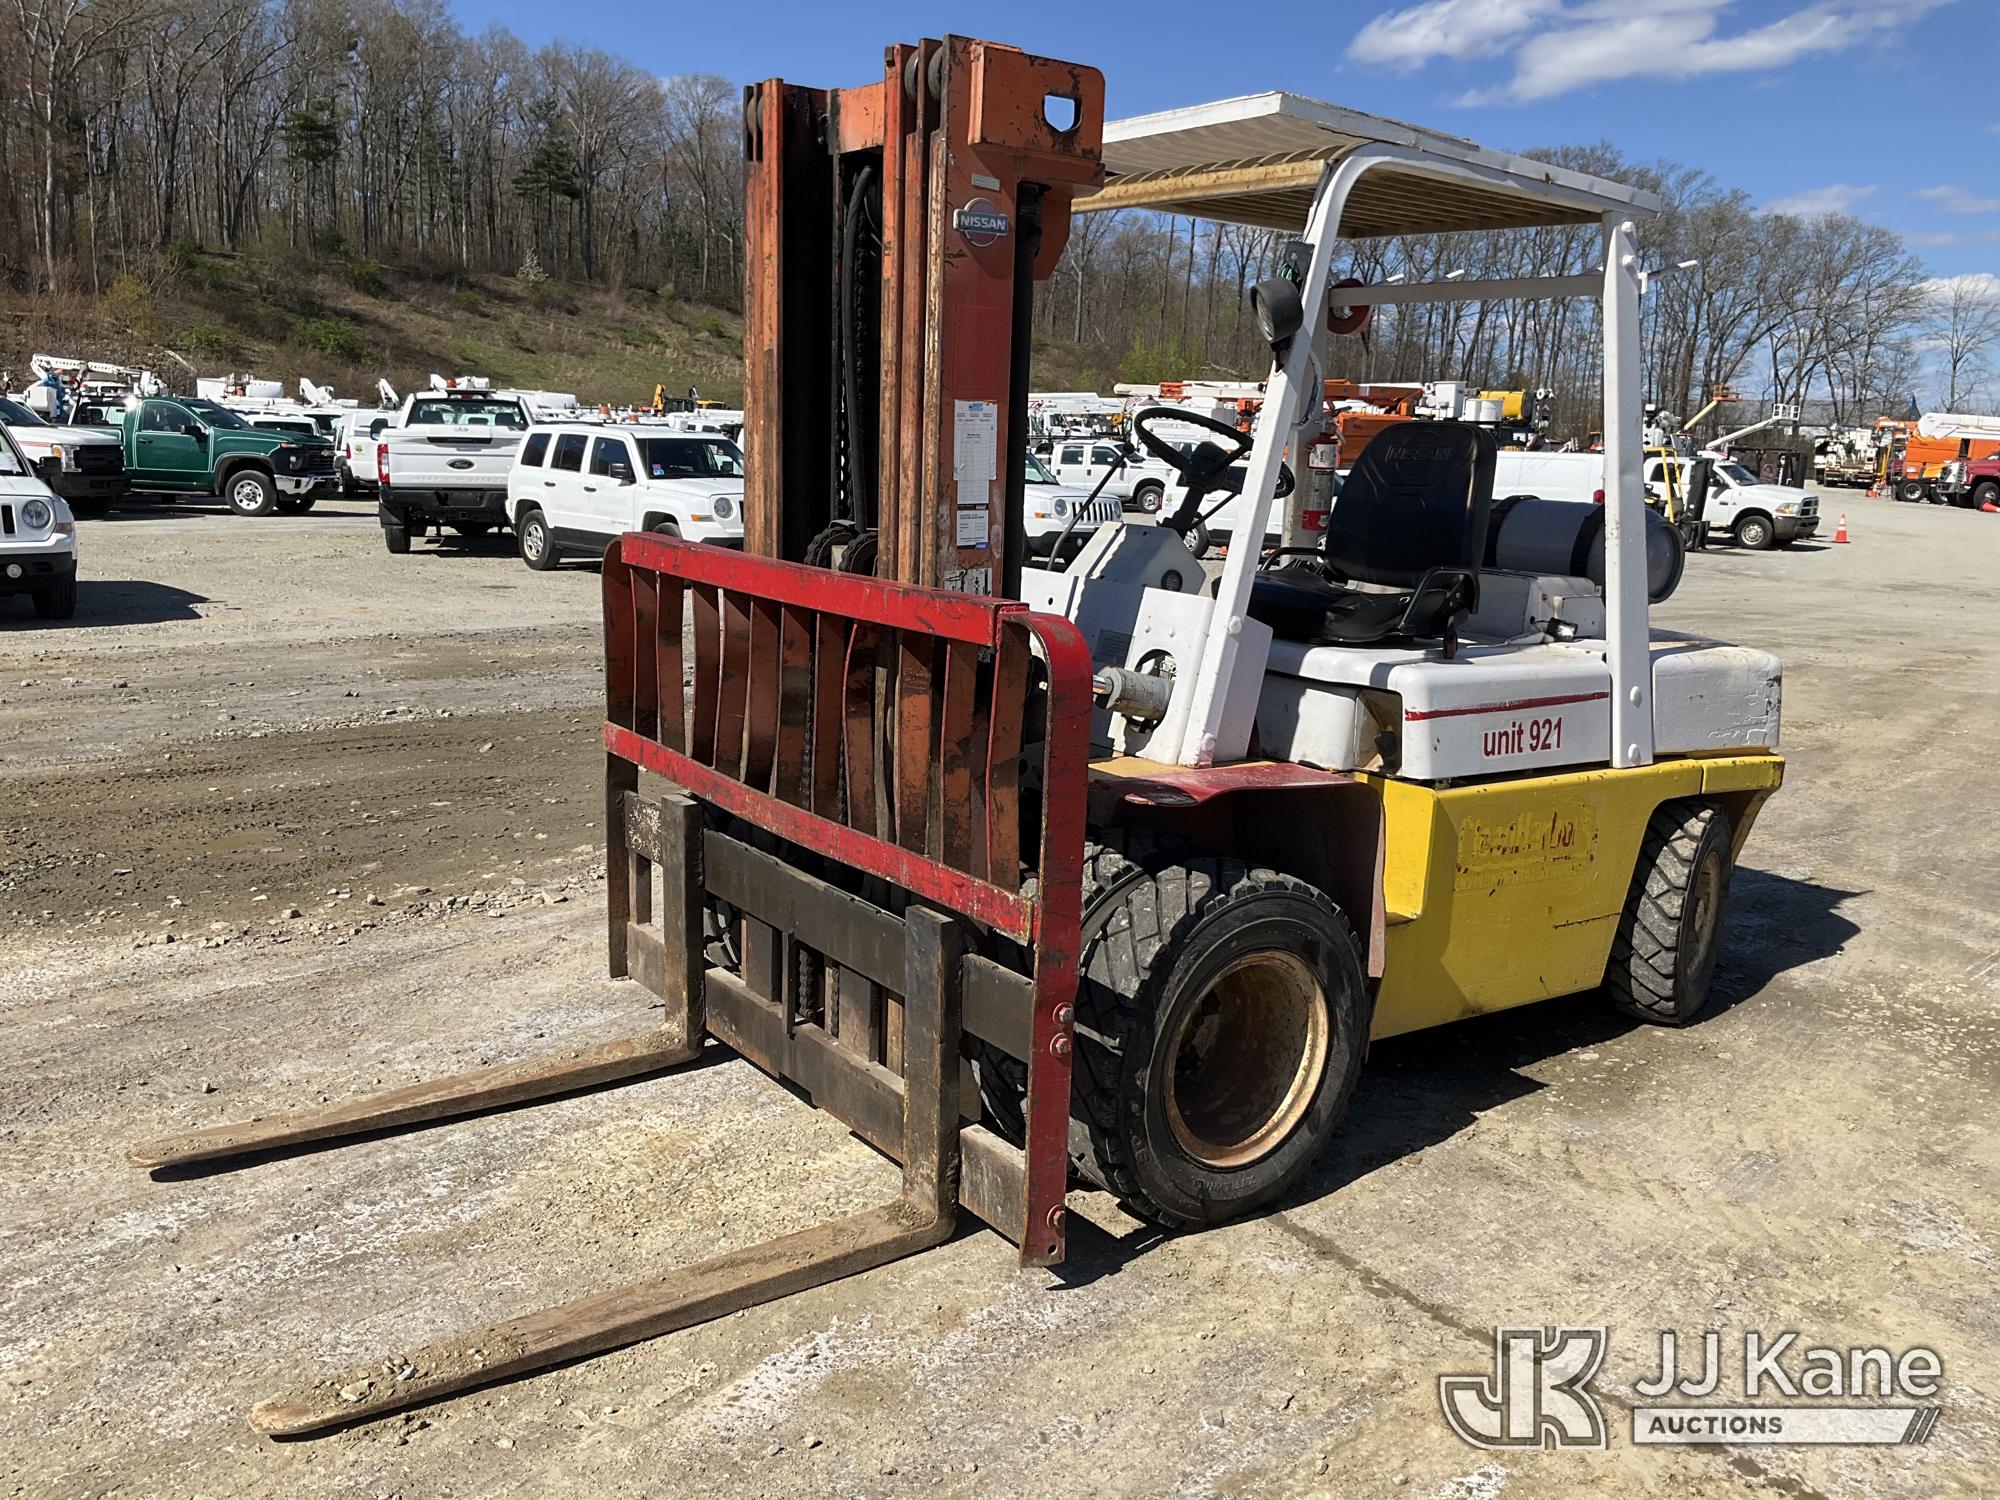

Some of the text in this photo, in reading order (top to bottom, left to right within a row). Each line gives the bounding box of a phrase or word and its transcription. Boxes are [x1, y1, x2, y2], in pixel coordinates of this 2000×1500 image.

[960, 215, 1006, 231] NISSAN
[1483, 716, 1562, 757] unit 921
